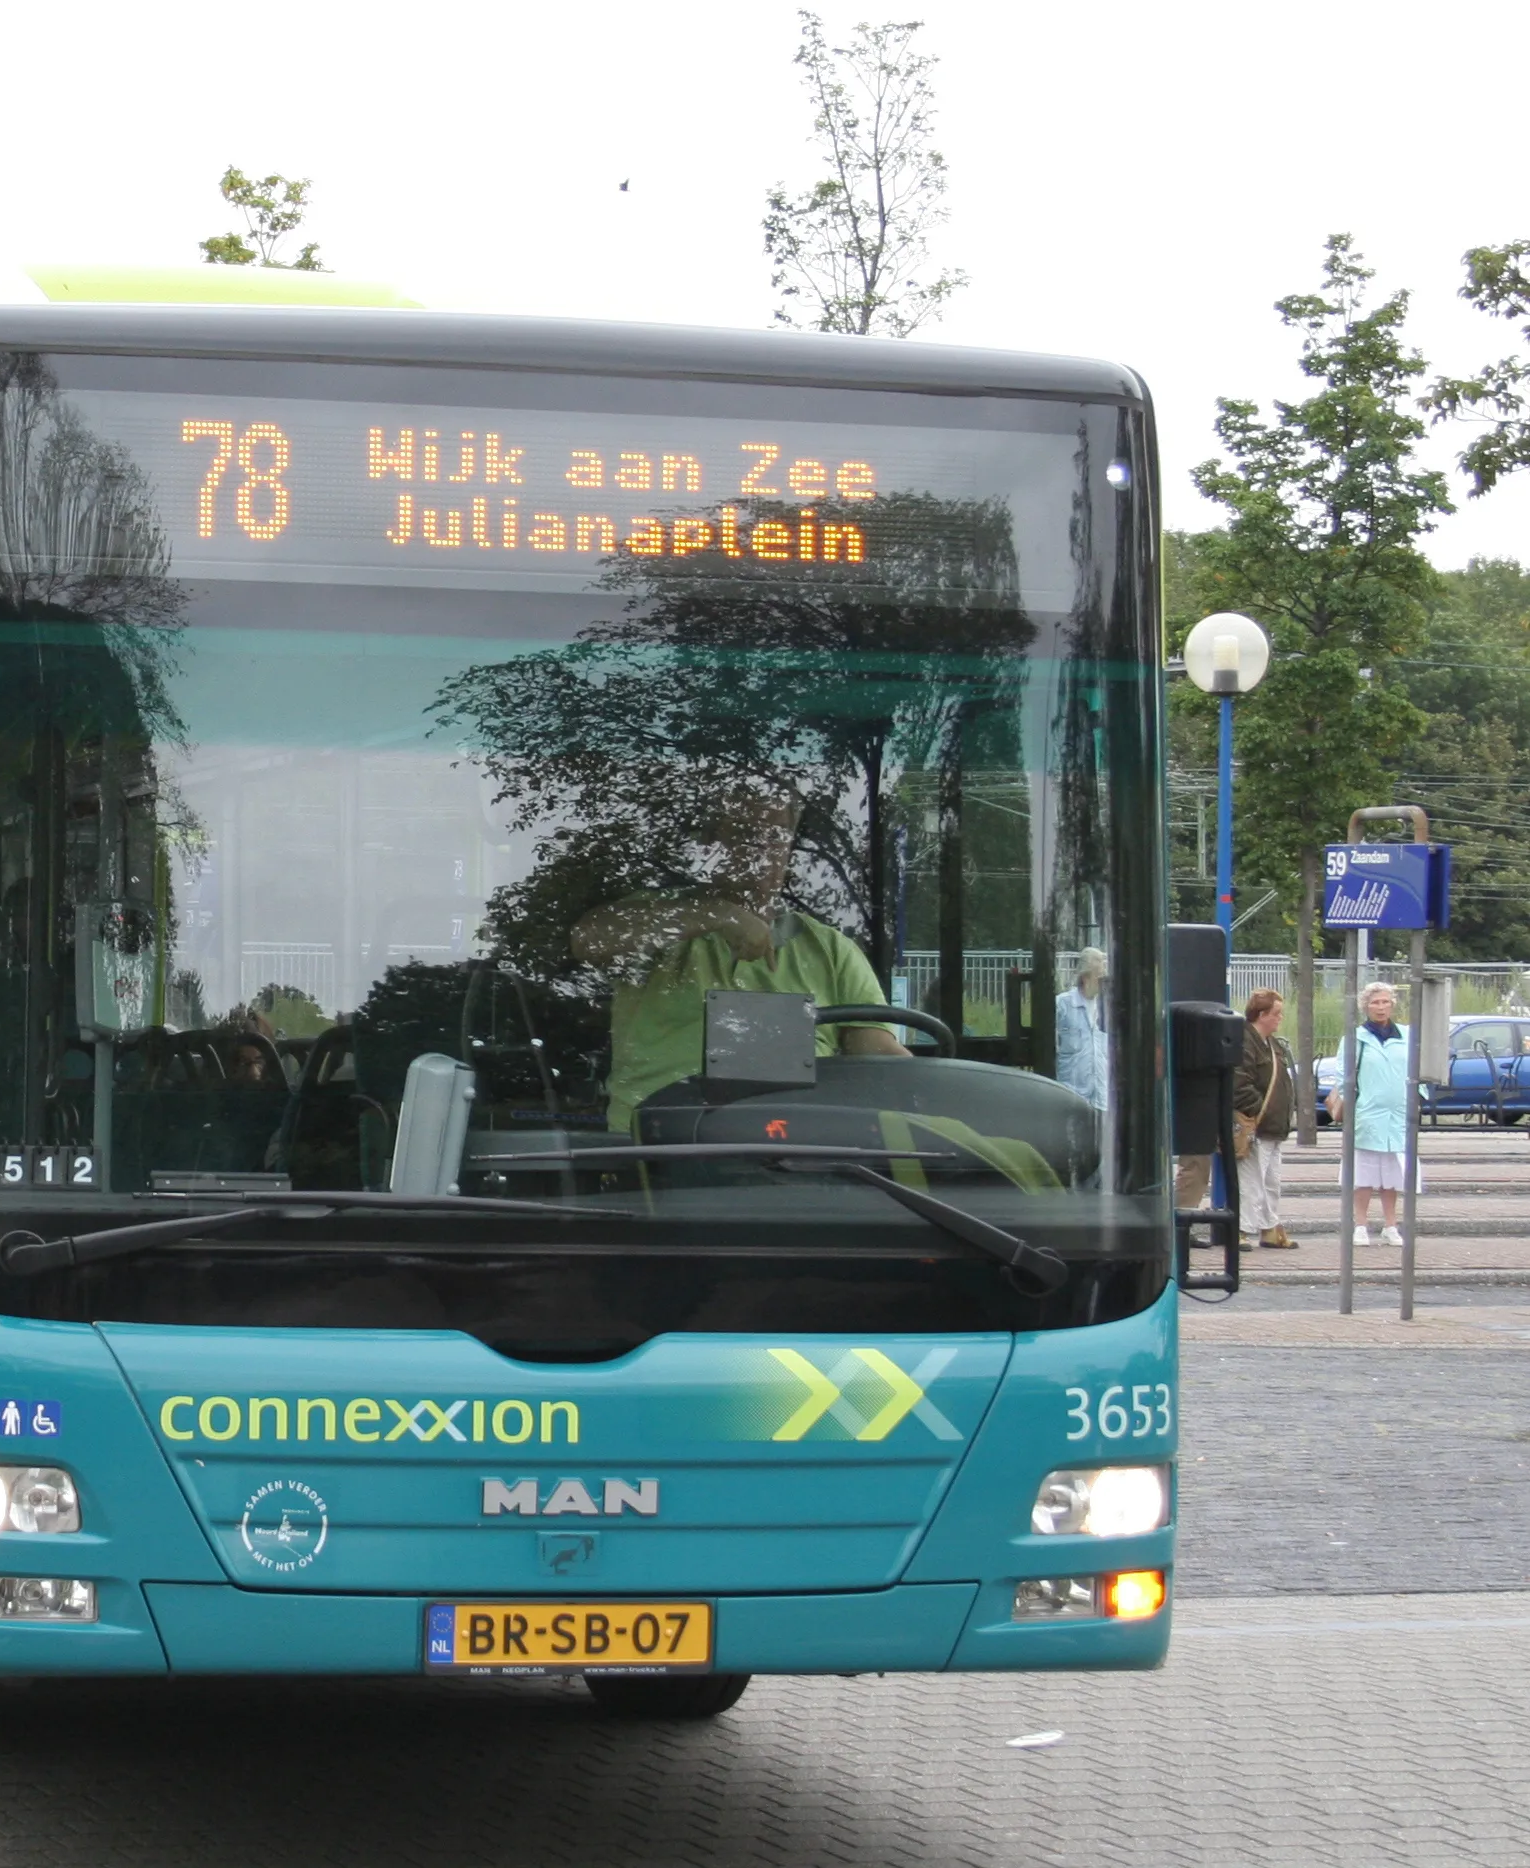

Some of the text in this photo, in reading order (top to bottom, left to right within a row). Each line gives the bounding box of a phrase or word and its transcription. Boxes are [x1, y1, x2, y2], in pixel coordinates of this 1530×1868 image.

[180, 420, 876, 538] 78 Wijk aan Zee
[386, 493, 865, 563] Julianaplein
[1326, 850, 1390, 876] 59 Zaandam
[4, 1155, 93, 1183] 512
[159, 1395, 581, 1444] connexxion
[1065, 1382, 1171, 1441] 3653
[245, 1479, 327, 1513] SAMEN VERDER
[481, 1477, 660, 1516] MAN
[252, 1551, 314, 1571] MET HET OV
[432, 1639, 451, 1655] NL
[469, 1612, 691, 1656] BR-SB-07
